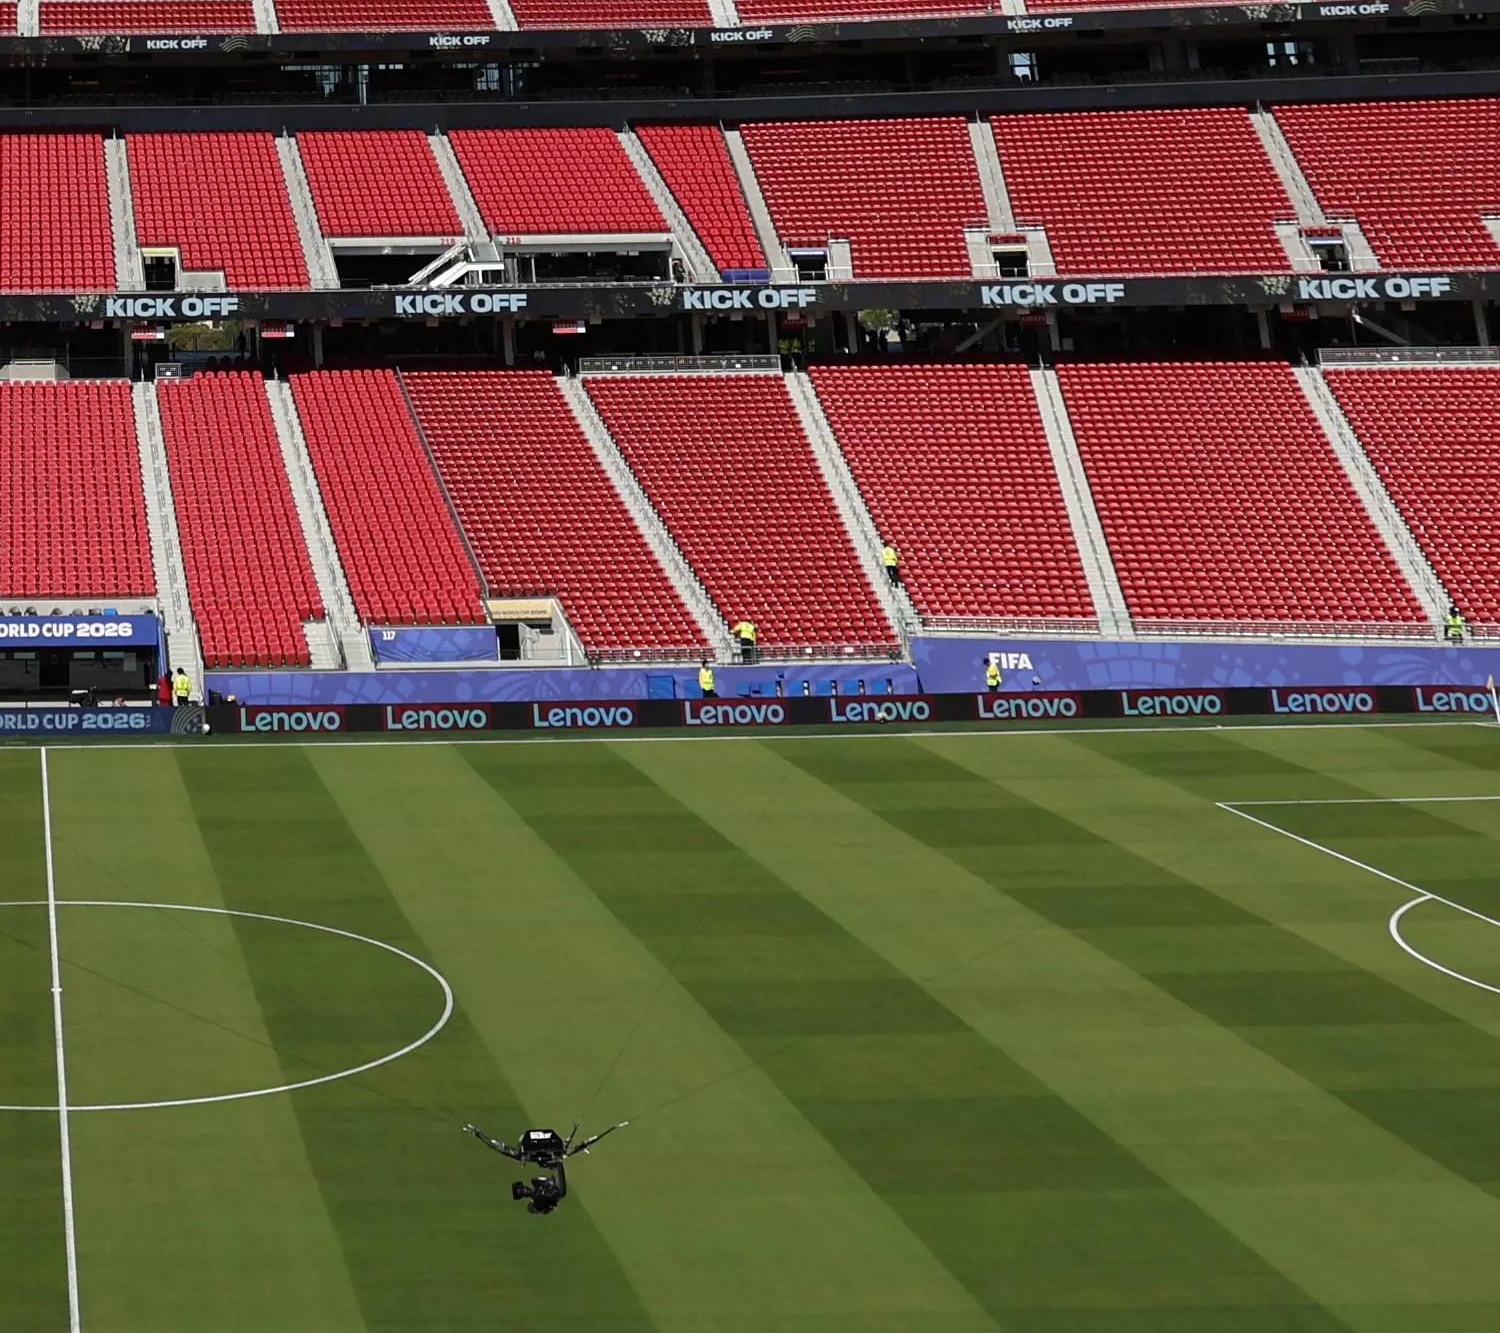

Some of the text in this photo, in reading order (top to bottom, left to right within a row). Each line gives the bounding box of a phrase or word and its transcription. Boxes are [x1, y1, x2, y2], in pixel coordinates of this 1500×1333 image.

[1320, 2, 1389, 15] KICK OFF
[147, 37, 207, 49] KICK OFF
[711, 30, 772, 41] KICK OFF
[683, 287, 816, 309] KICK OFF
[981, 284, 1124, 305] KICK OFF
[1298, 276, 1451, 299] KICK OFF
[106, 295, 238, 317] KICK OFF
[395, 294, 527, 315] KICK OFF
[43, 624, 74, 637] CUP
[76, 622, 133, 637] 2026
[383, 631, 395, 640] 117
[989, 652, 1033, 669] FIFA
[684, 700, 785, 723] Lenovo
[830, 696, 931, 722] Lenovo
[977, 695, 1075, 717] Lenovo
[1124, 691, 1221, 714] Lenovo
[1273, 691, 1371, 712] Lenovo
[42, 714, 78, 729] CUP
[82, 713, 145, 729] 2026
[242, 707, 339, 730] Lenovo
[390, 705, 486, 729] Lenovo
[535, 704, 632, 726] Lenovo
